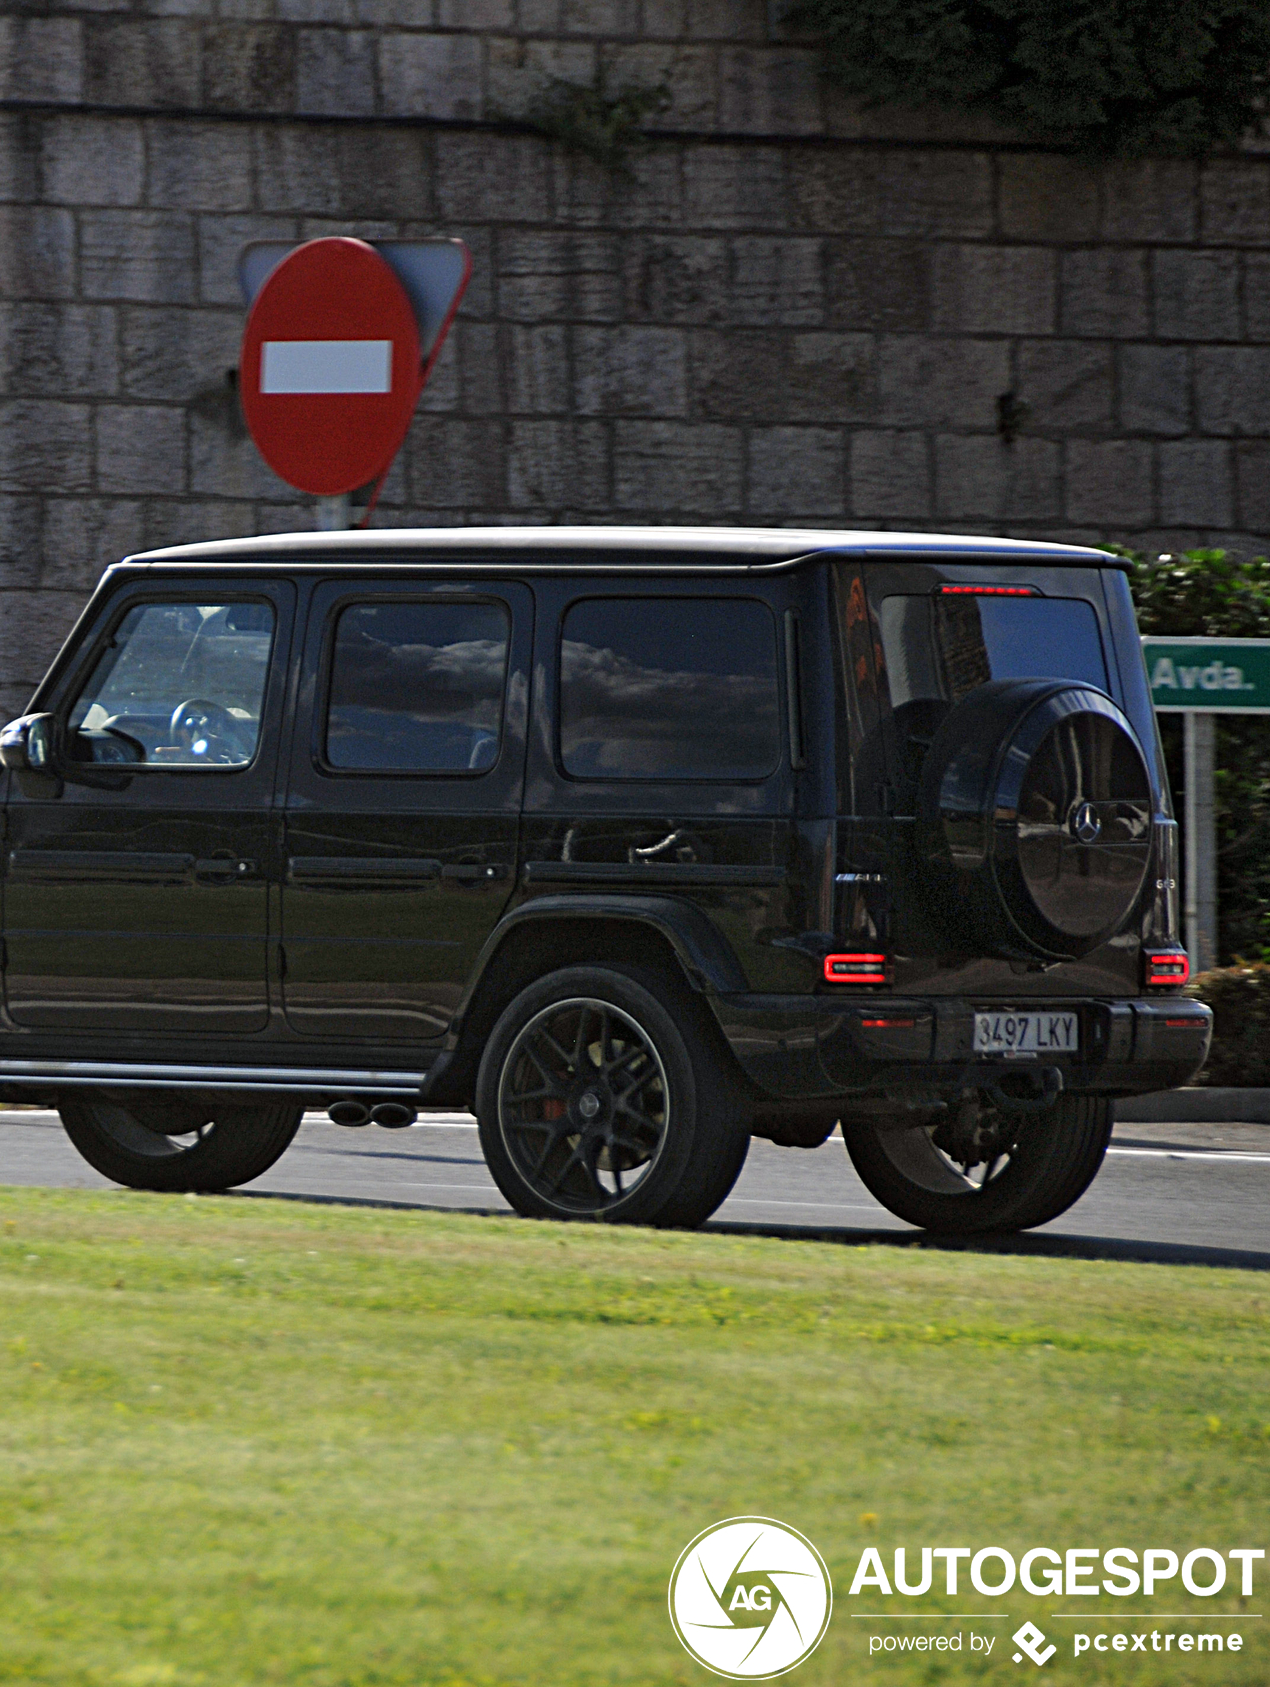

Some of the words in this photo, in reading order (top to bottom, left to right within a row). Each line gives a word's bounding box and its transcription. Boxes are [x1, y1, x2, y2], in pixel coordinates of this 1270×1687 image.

[1150, 657, 1255, 689] Avda.
[979, 1017, 1029, 1046] 3497
[1036, 1017, 1073, 1046] LKY
